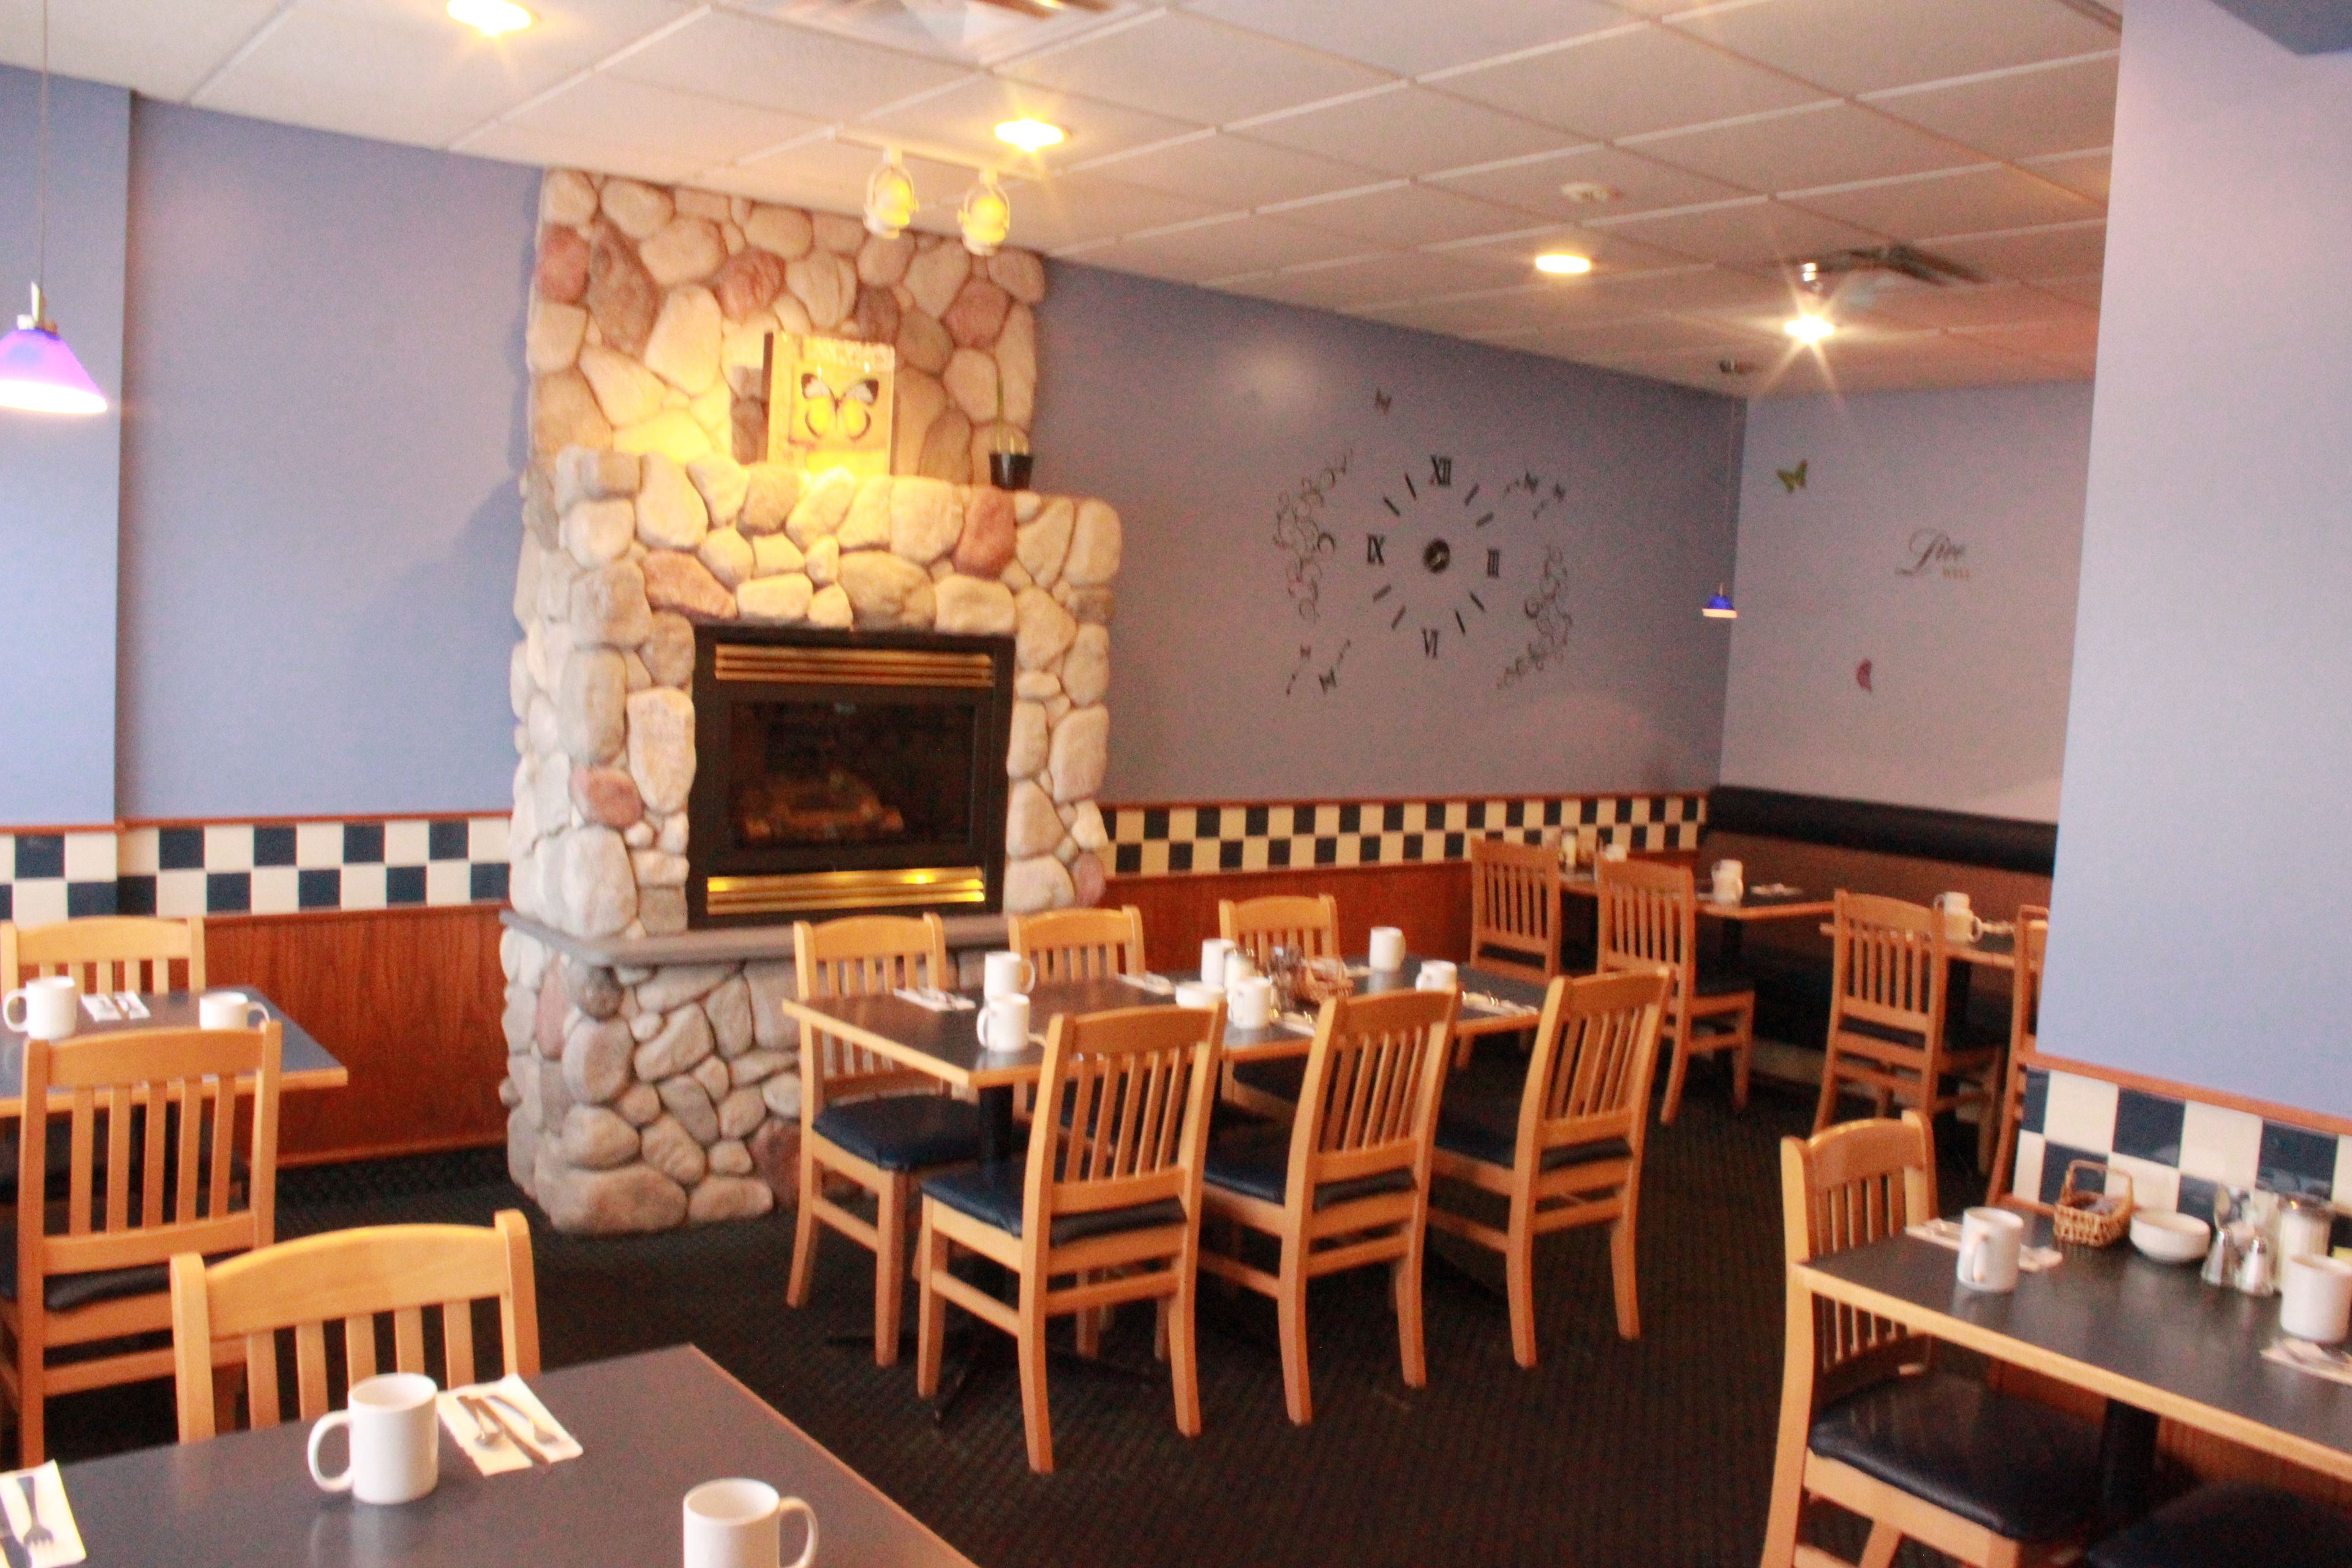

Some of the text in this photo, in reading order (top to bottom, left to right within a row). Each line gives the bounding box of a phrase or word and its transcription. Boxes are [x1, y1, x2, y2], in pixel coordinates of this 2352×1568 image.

[1430, 455, 1452, 486] XII
[1367, 533, 1385, 565] IX
[1488, 549, 1501, 578] III
[1422, 628, 1439, 658] VI
